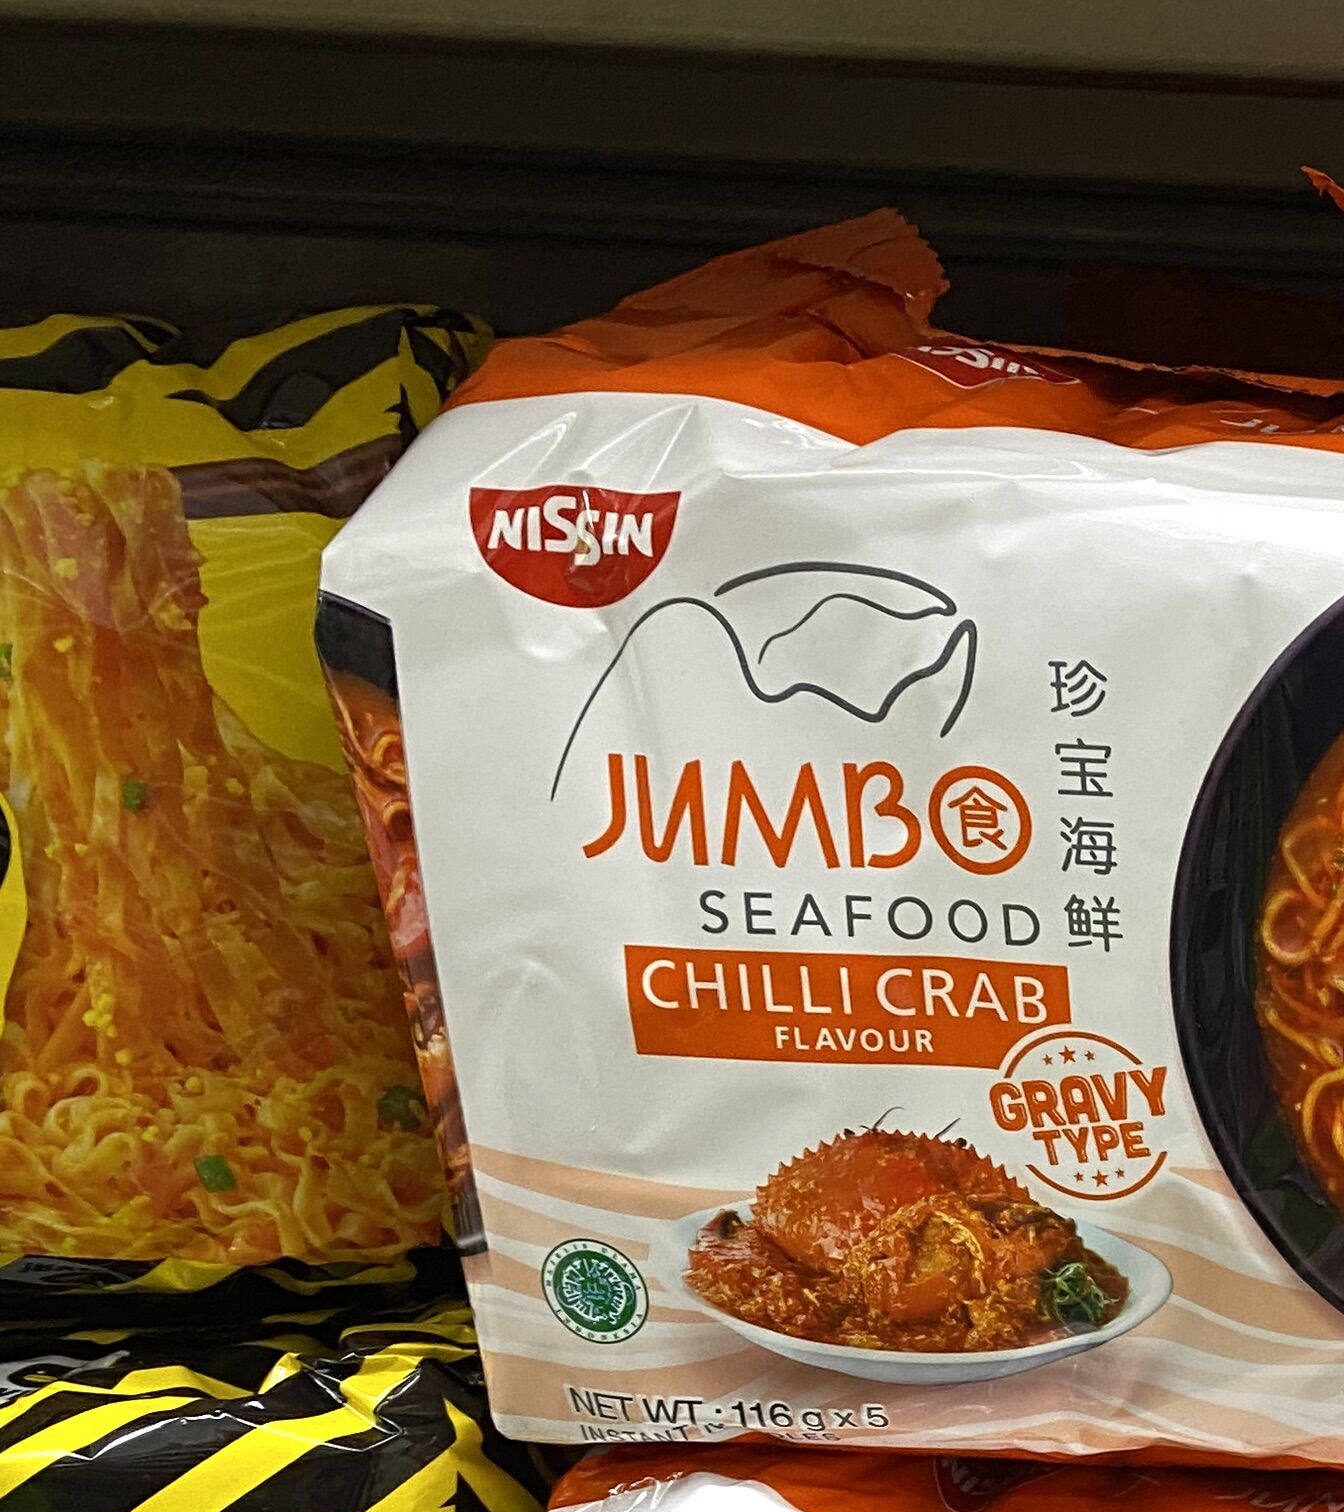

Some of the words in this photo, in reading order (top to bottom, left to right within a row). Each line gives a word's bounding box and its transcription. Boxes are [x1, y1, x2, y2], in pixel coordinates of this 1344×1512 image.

[487, 496, 654, 567] NISSIN
[1047, 660, 1124, 953] 珍宝海鲜
[700, 889, 1041, 948] SEAFOOD
[641, 959, 853, 1017] CHILLI
[875, 967, 1048, 1024] CRAB
[775, 1026, 934, 1054] FLAVOUR
[988, 1066, 1168, 1132] GRAVY
[1033, 1122, 1152, 1167] TYPE
[567, 1386, 633, 1422] NET
